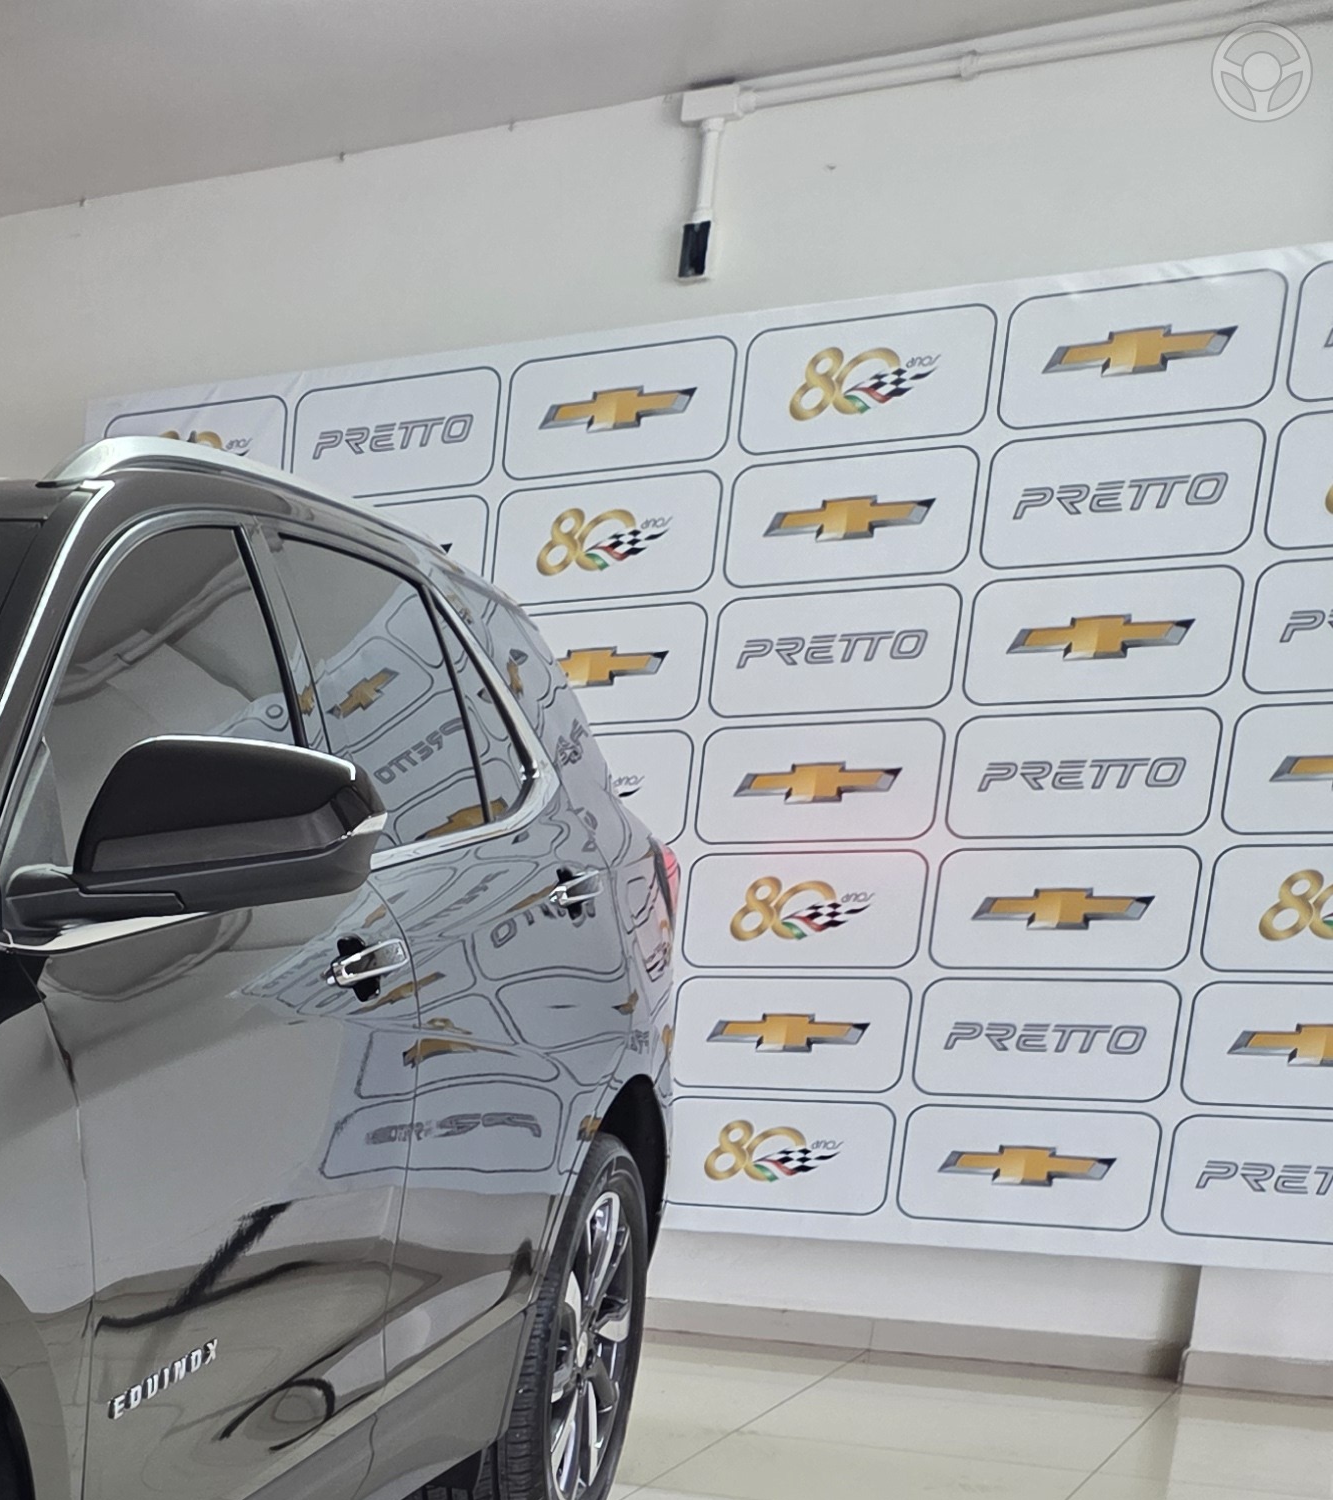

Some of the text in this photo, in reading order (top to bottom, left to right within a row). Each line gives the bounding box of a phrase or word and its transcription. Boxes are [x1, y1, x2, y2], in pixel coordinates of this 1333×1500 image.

[312, 413, 474, 461] PRETTO
[1012, 471, 1229, 521] PRETTO
[736, 628, 929, 670] PRETTO
[977, 757, 1187, 793] PRETTO
[943, 1021, 1148, 1055] PRETTO
